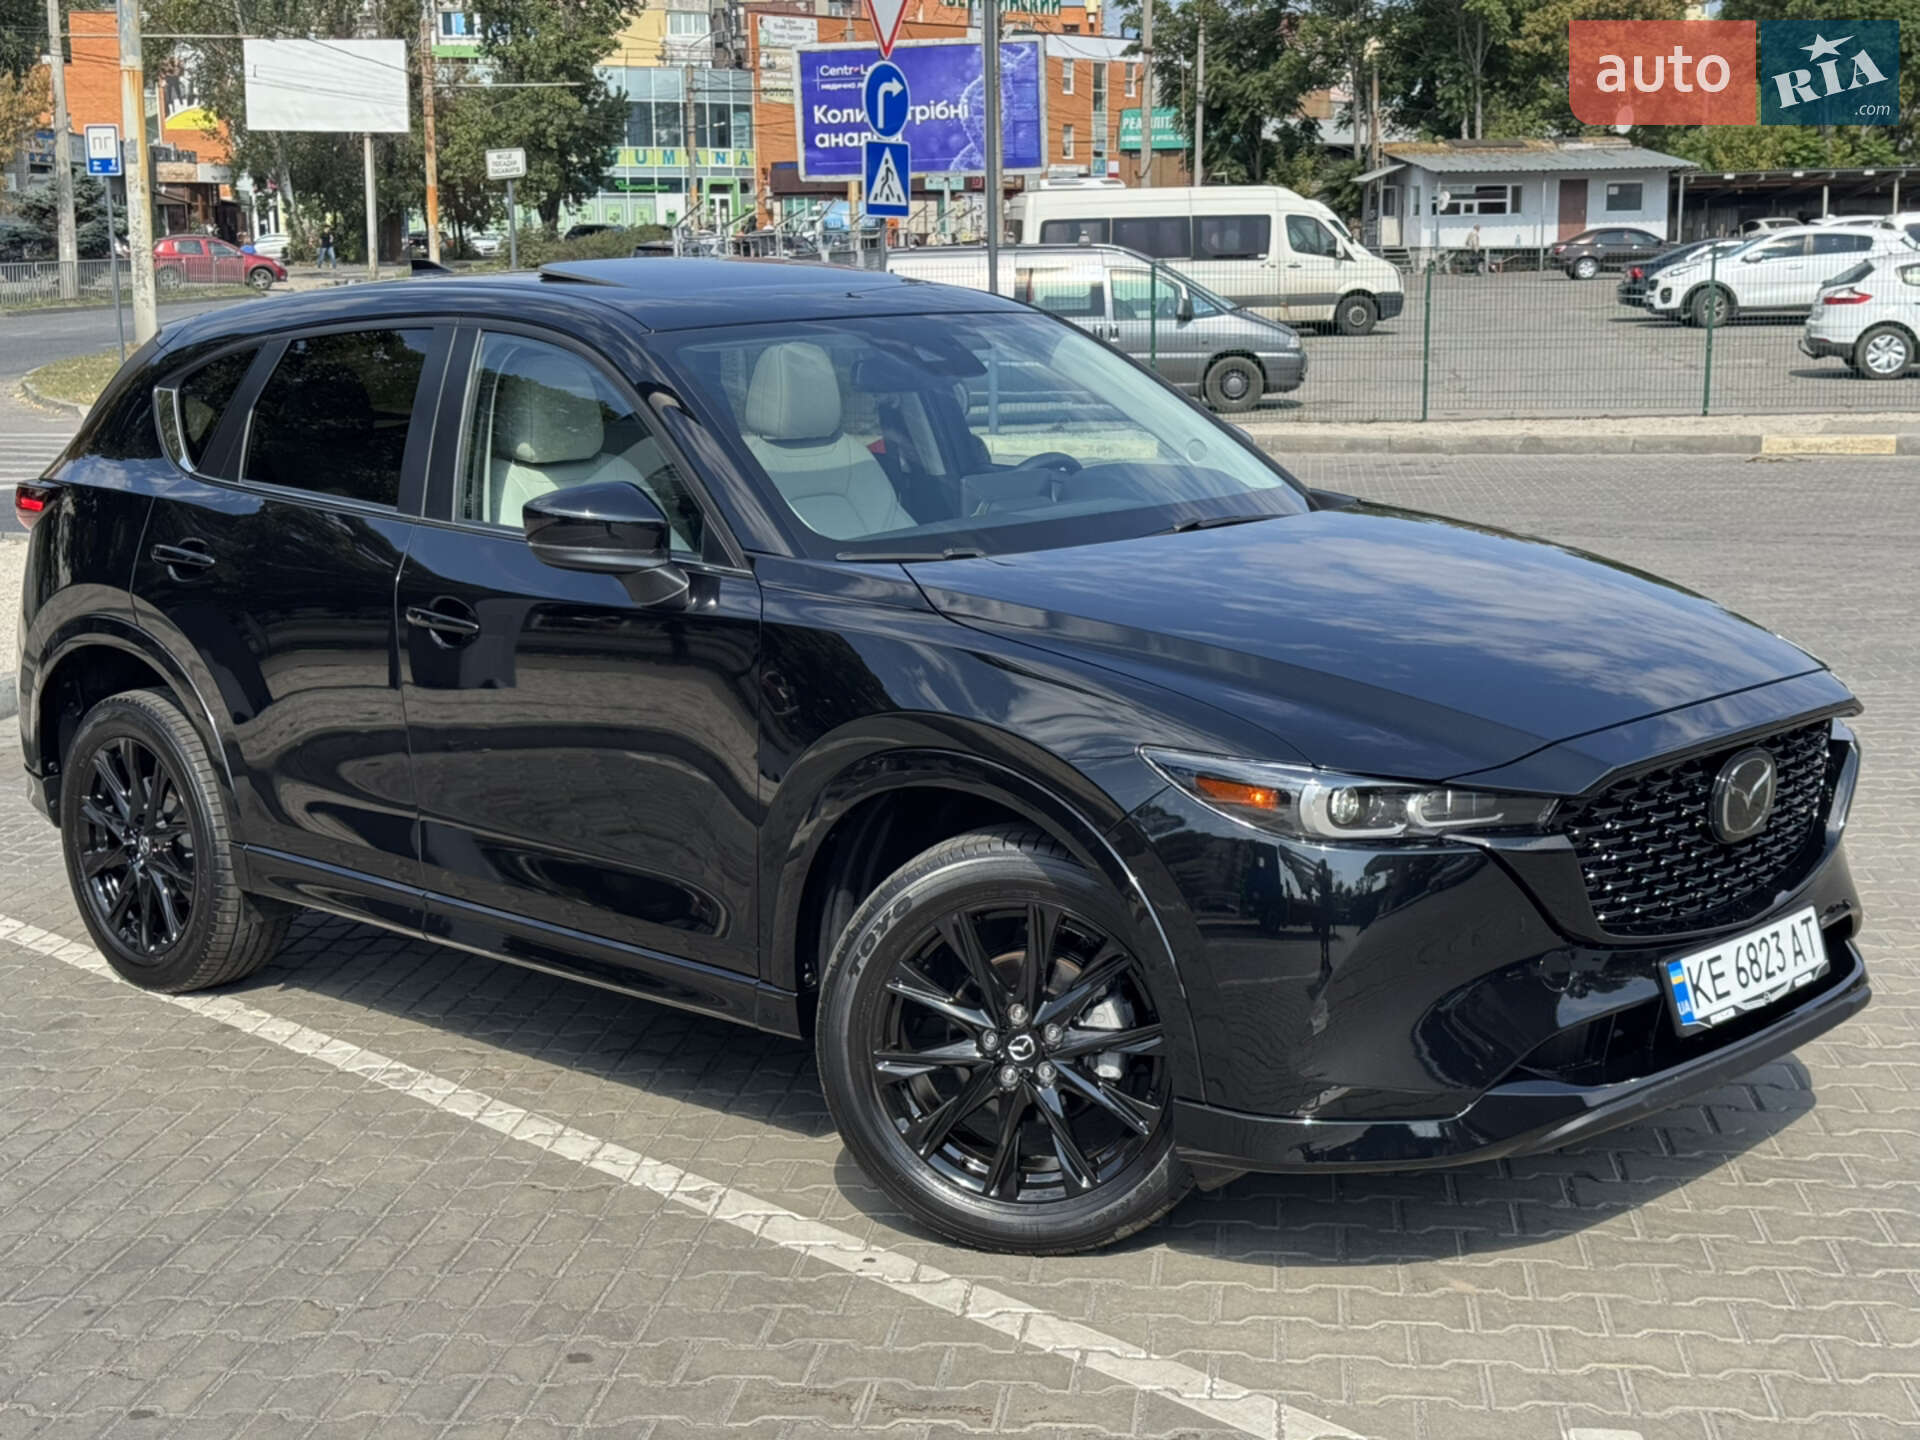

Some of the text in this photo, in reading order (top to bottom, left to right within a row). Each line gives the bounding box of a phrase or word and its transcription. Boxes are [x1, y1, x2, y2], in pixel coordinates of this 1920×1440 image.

[92, 136, 112, 150] ПГ
[847, 896, 913, 978] TOYO
[1686, 916, 1816, 1009] KE 6823 AT
[1677, 1000, 1692, 1017] UA
